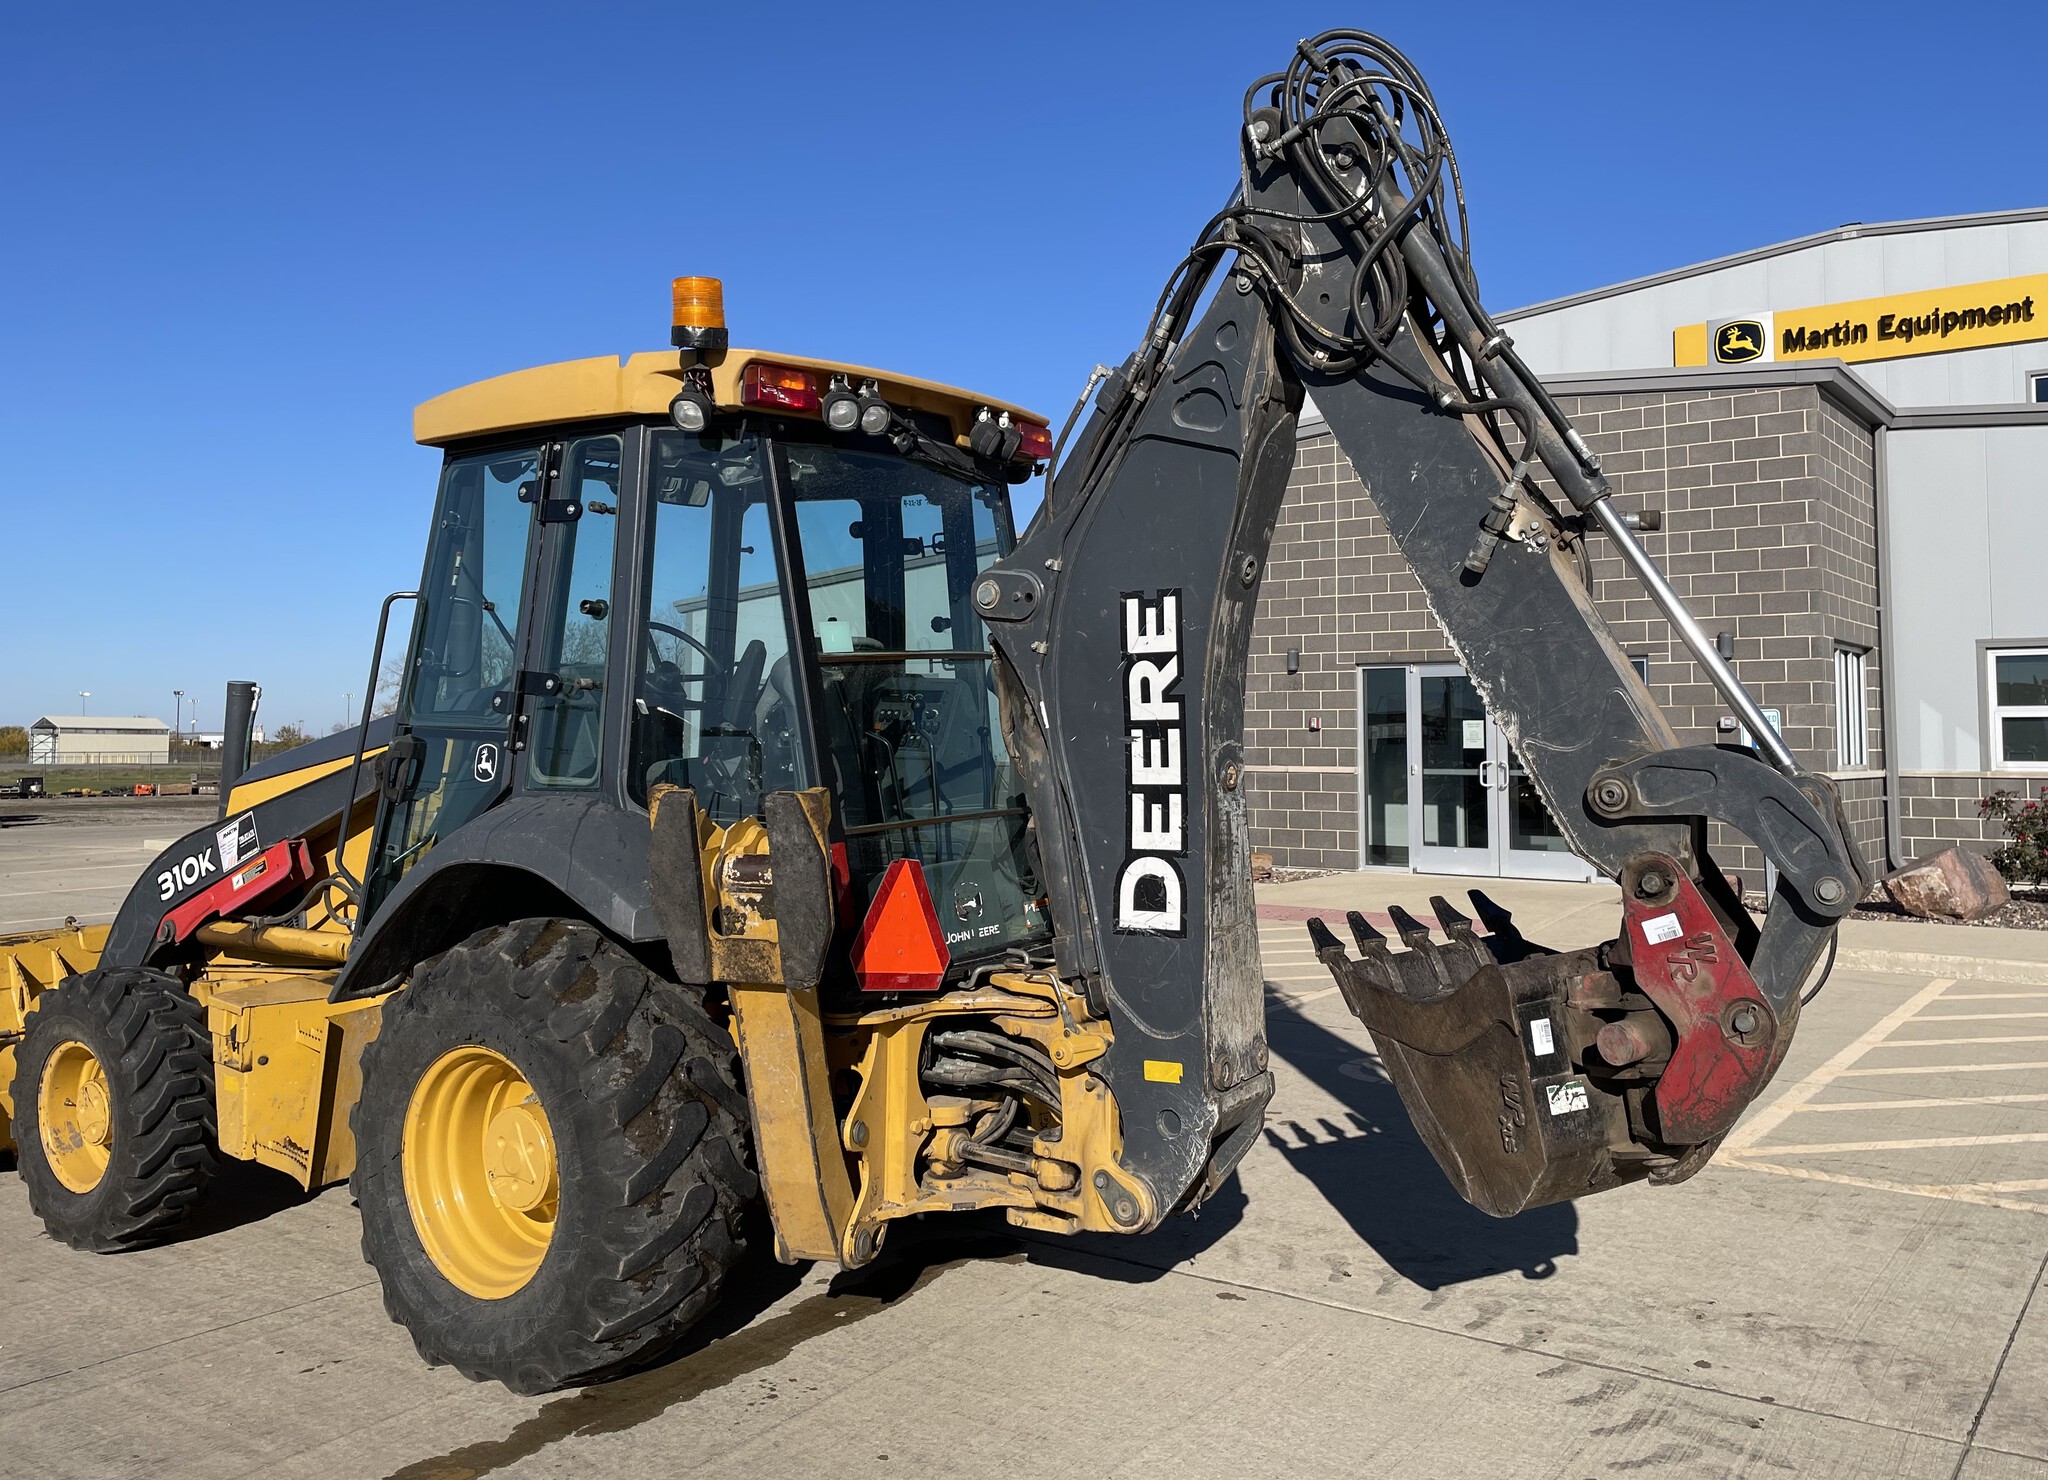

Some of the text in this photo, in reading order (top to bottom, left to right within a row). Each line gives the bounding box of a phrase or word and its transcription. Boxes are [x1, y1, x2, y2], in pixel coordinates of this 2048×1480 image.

[1782, 296, 2035, 354] Martin Equipment
[1118, 595, 1183, 931] DEERE
[157, 848, 216, 901] 310K
[945, 930, 970, 945] JOHN
